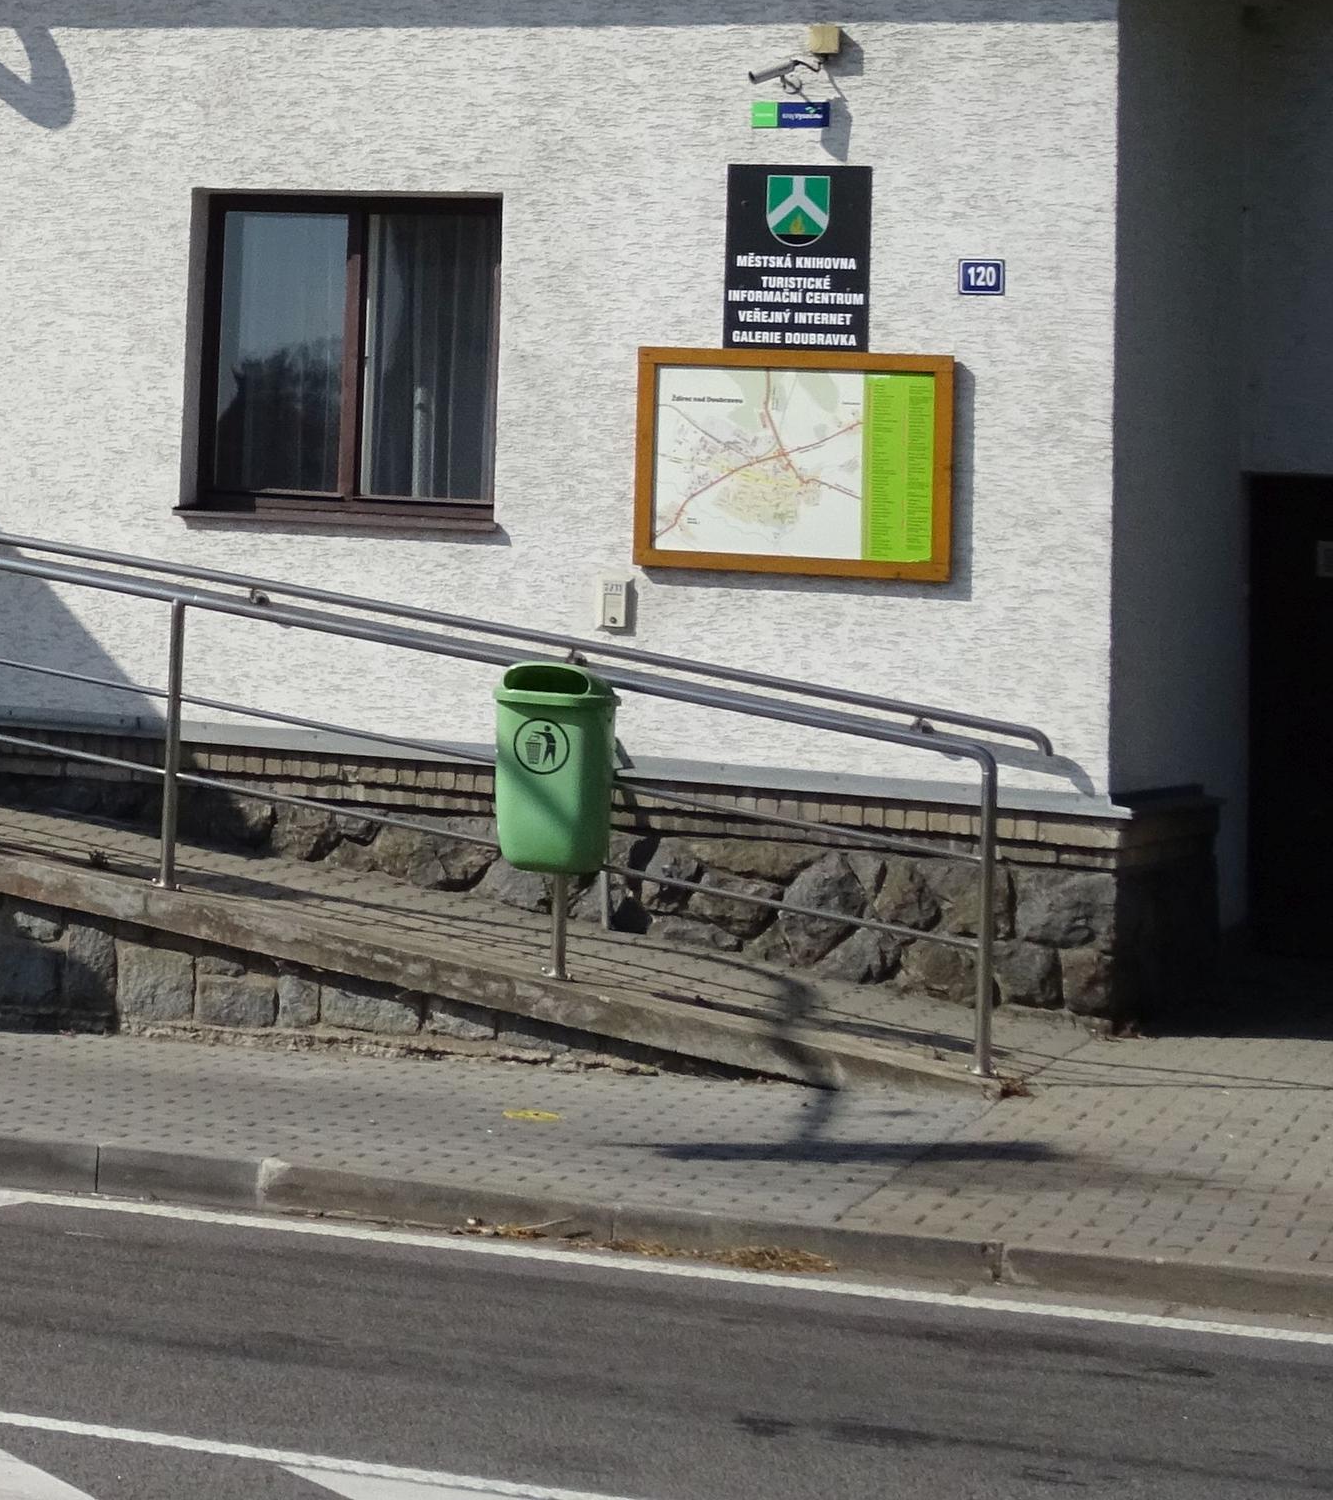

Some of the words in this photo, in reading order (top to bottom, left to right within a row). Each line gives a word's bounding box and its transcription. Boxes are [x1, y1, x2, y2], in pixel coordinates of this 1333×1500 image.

[736, 252, 792, 269] MĚSTSKÁ
[795, 256, 857, 270] KNIHOVNA
[761, 274, 831, 290] TURISTICKÉ
[967, 266, 997, 287] 120
[727, 288, 803, 303] INFORMAČNÍ
[805, 291, 864, 305] CENTRUM
[737, 307, 791, 323] VEŘEJNÝ
[794, 311, 853, 325] INTERNET
[732, 330, 782, 344] GALERIE
[784, 332, 857, 346] DOUBRAVKA
